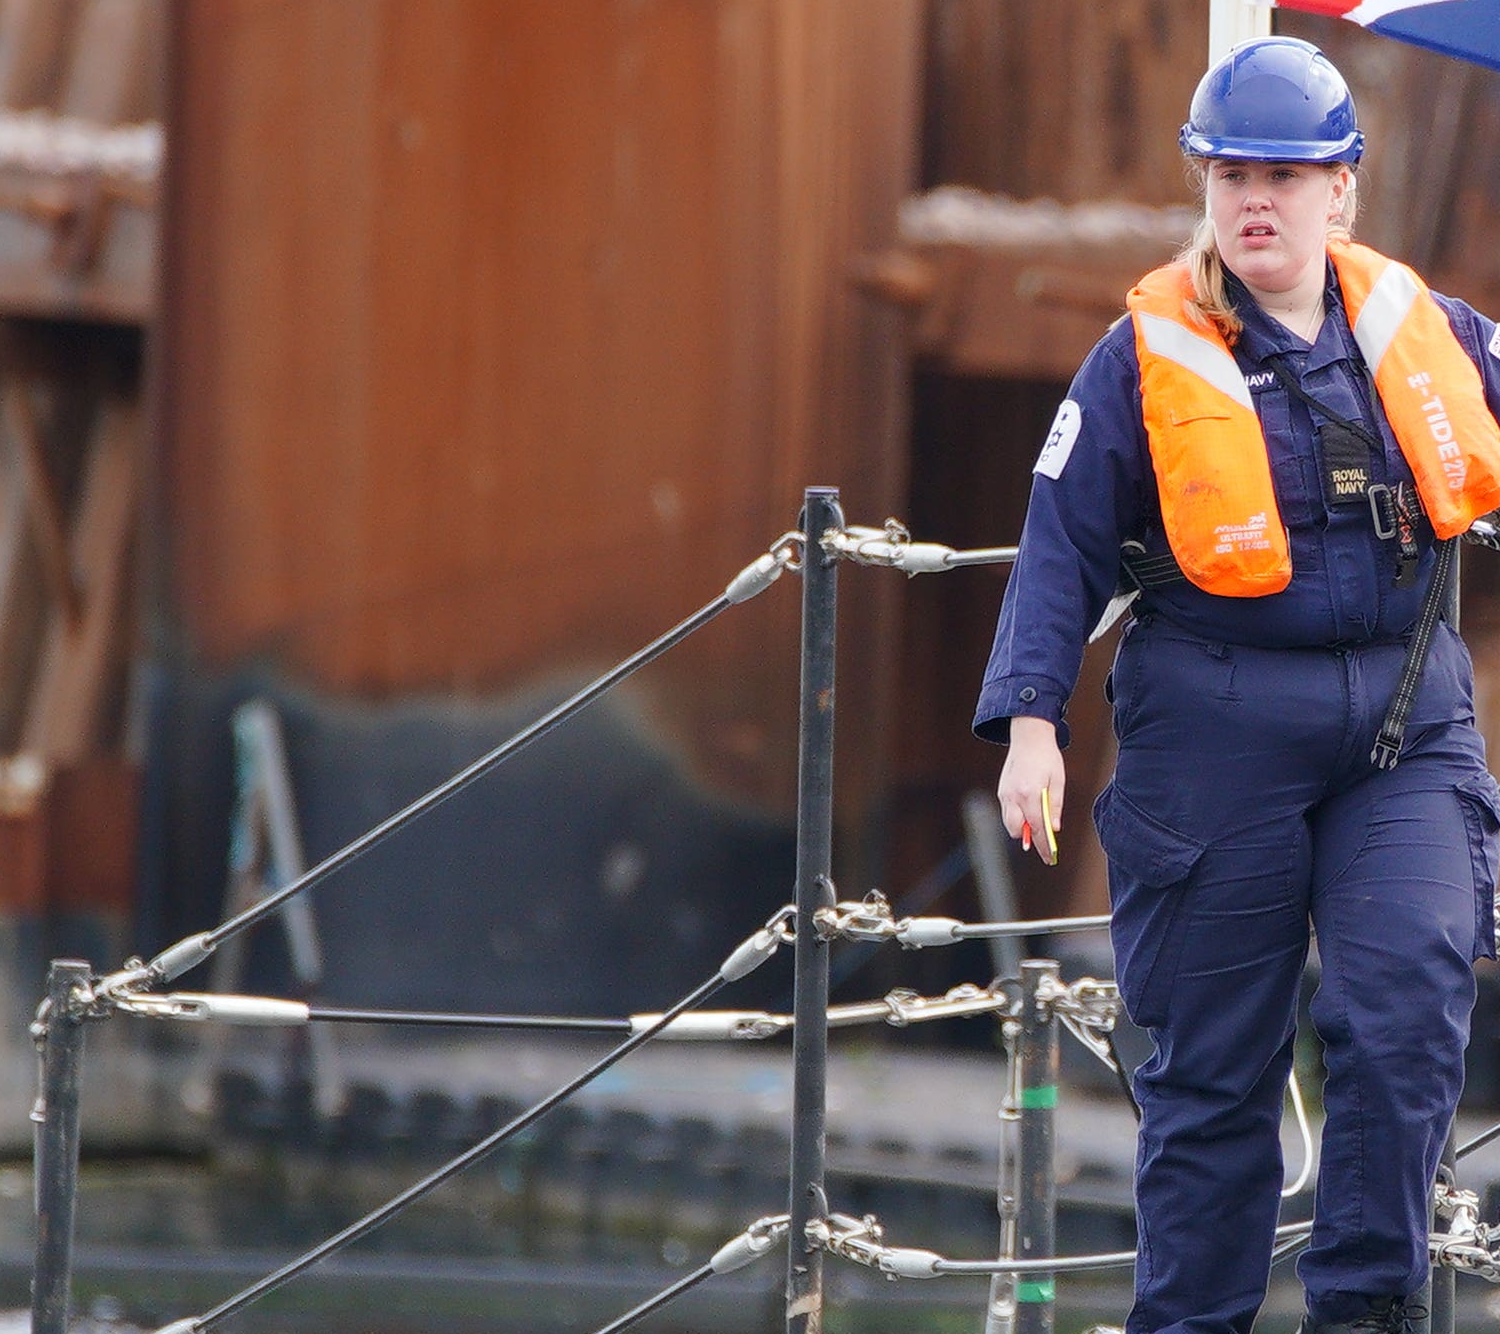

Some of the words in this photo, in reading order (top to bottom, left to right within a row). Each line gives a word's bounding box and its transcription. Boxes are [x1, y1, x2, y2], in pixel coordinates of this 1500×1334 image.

[1407, 371, 1461, 462] HI-TIDE
[1332, 468, 1367, 483] ROYAL
[1335, 481, 1366, 495] NAVY
